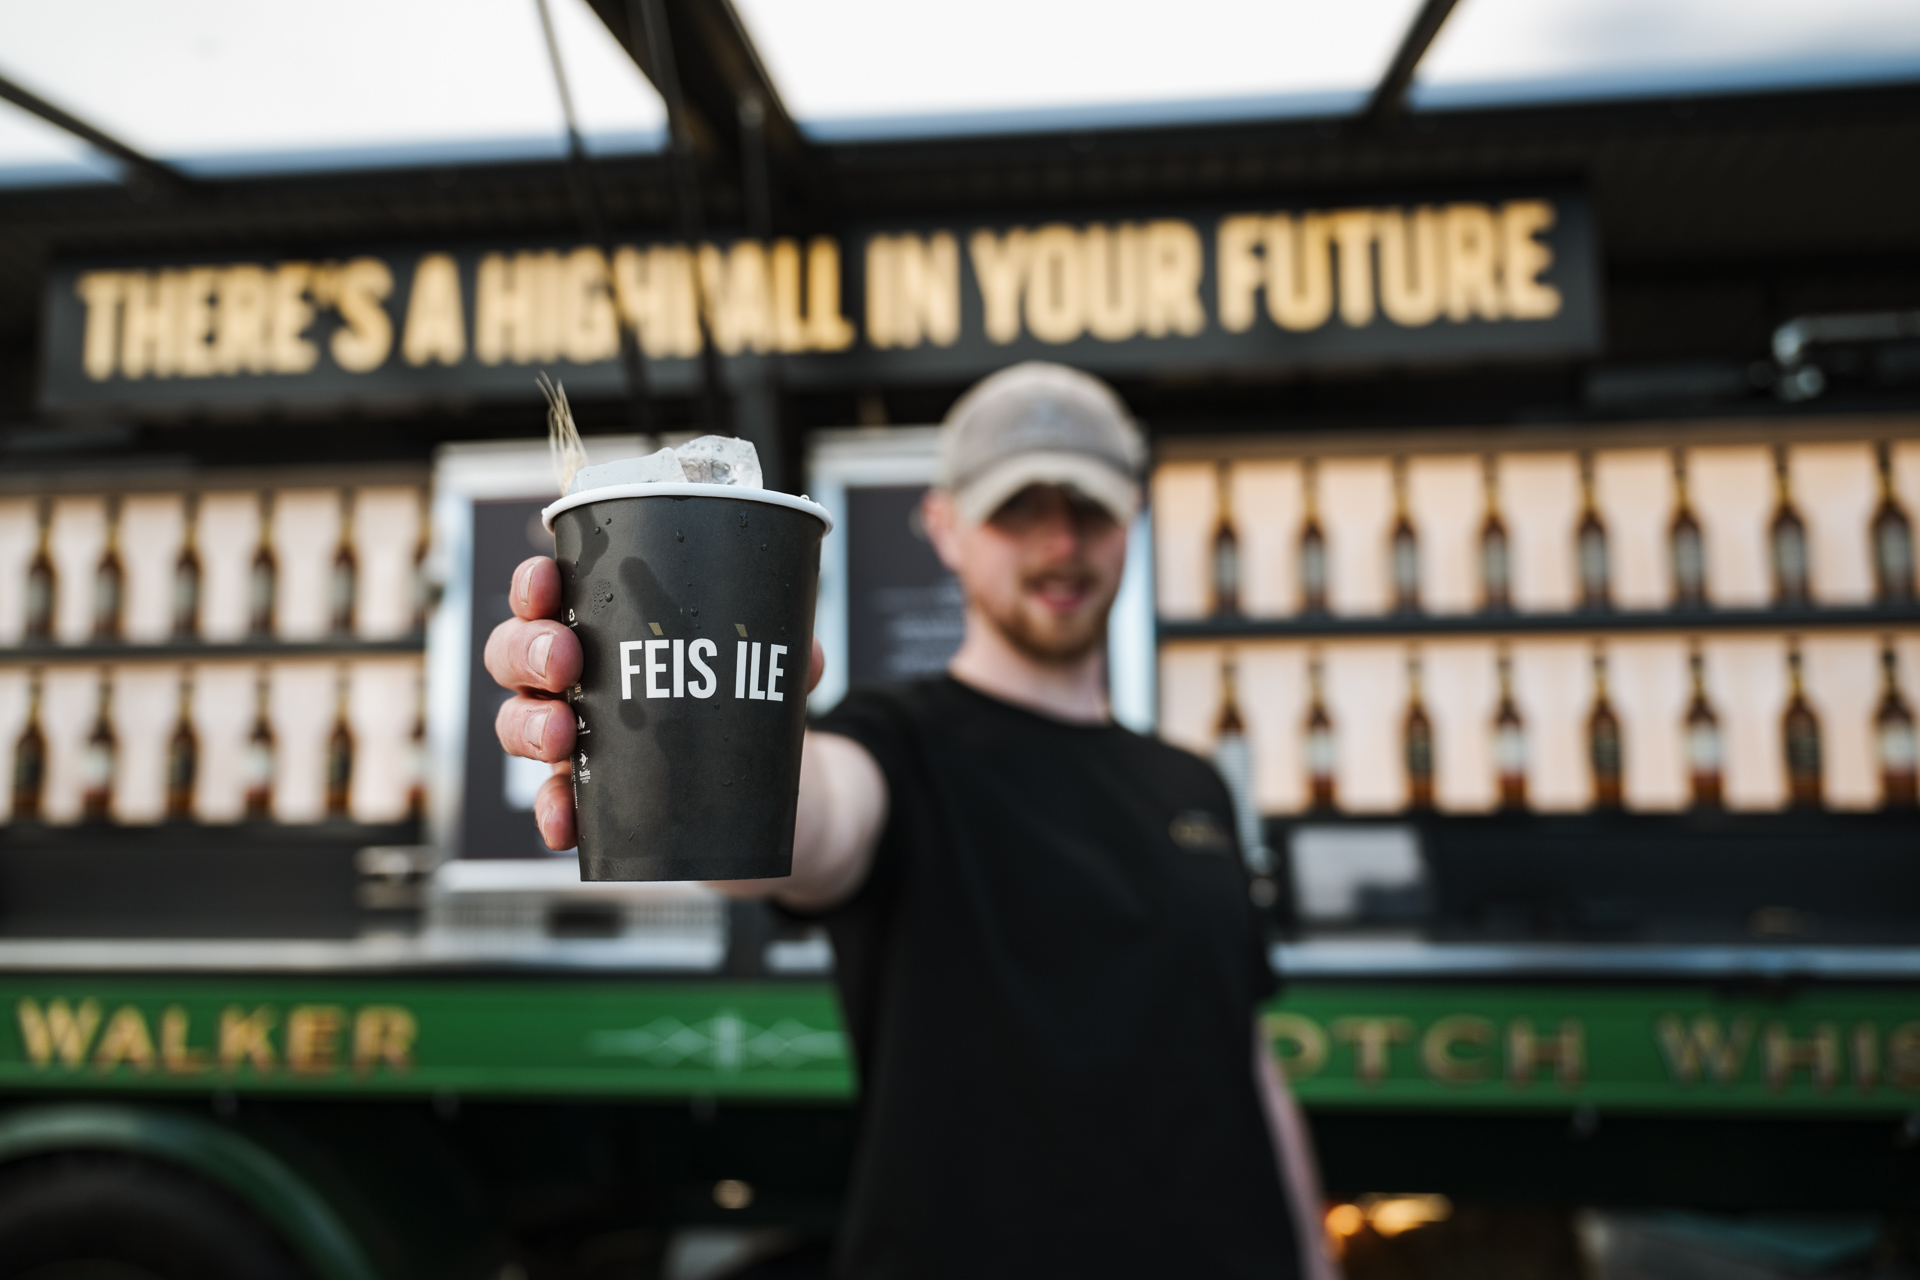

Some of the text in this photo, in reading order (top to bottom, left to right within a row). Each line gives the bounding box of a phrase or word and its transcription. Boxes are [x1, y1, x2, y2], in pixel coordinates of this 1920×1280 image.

[76, 257, 395, 380] THERE'S
[403, 253, 467, 366] A
[866, 229, 961, 348] IN
[969, 219, 1205, 344] YOUR
[1217, 200, 1561, 333] FUTURE
[619, 622, 718, 700] FÈIS
[734, 623, 788, 702] ÌLE
[17, 997, 418, 1077] WALKER
